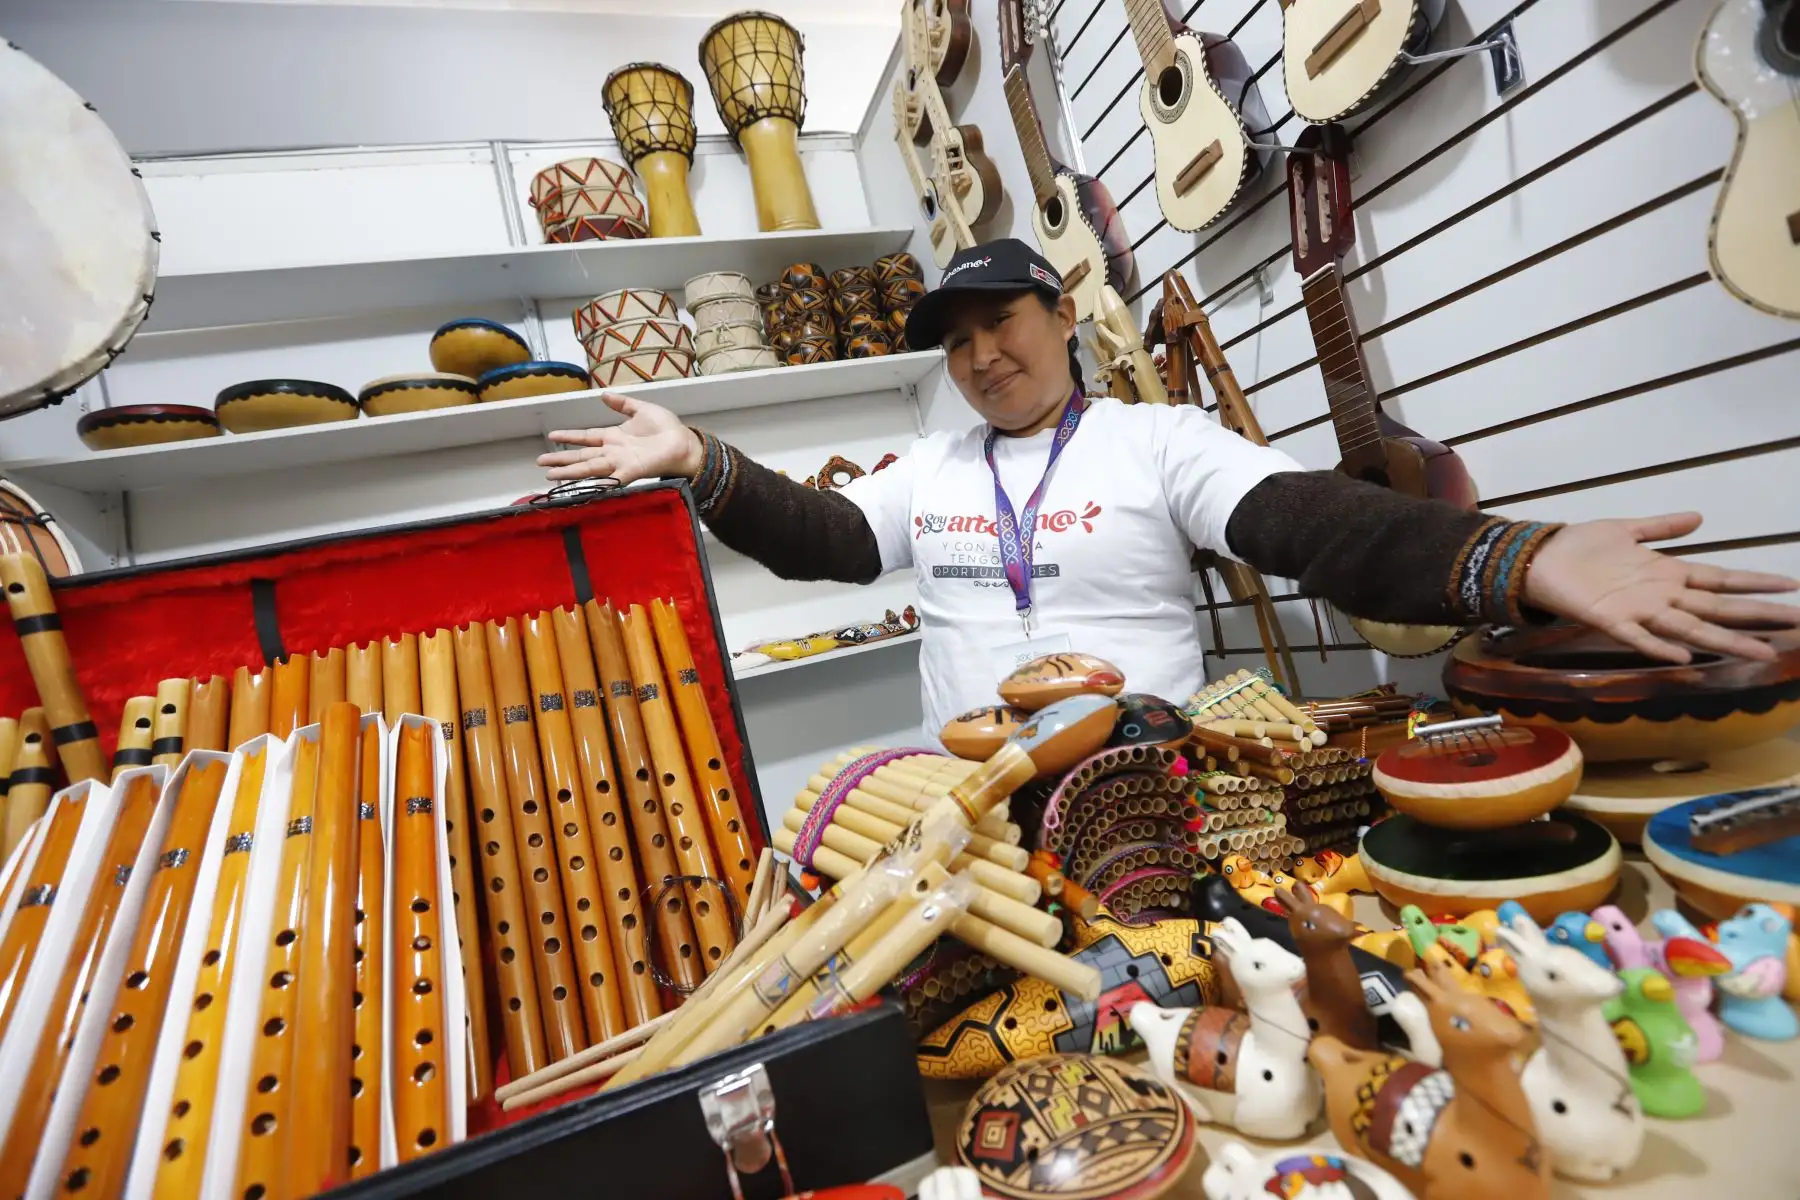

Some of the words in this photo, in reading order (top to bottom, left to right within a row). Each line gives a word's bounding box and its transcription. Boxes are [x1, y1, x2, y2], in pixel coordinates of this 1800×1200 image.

[923, 513, 948, 534] Soy
[942, 542, 948, 553] Y
[954, 541, 985, 552] CON
[950, 553, 1000, 565] TENGO
